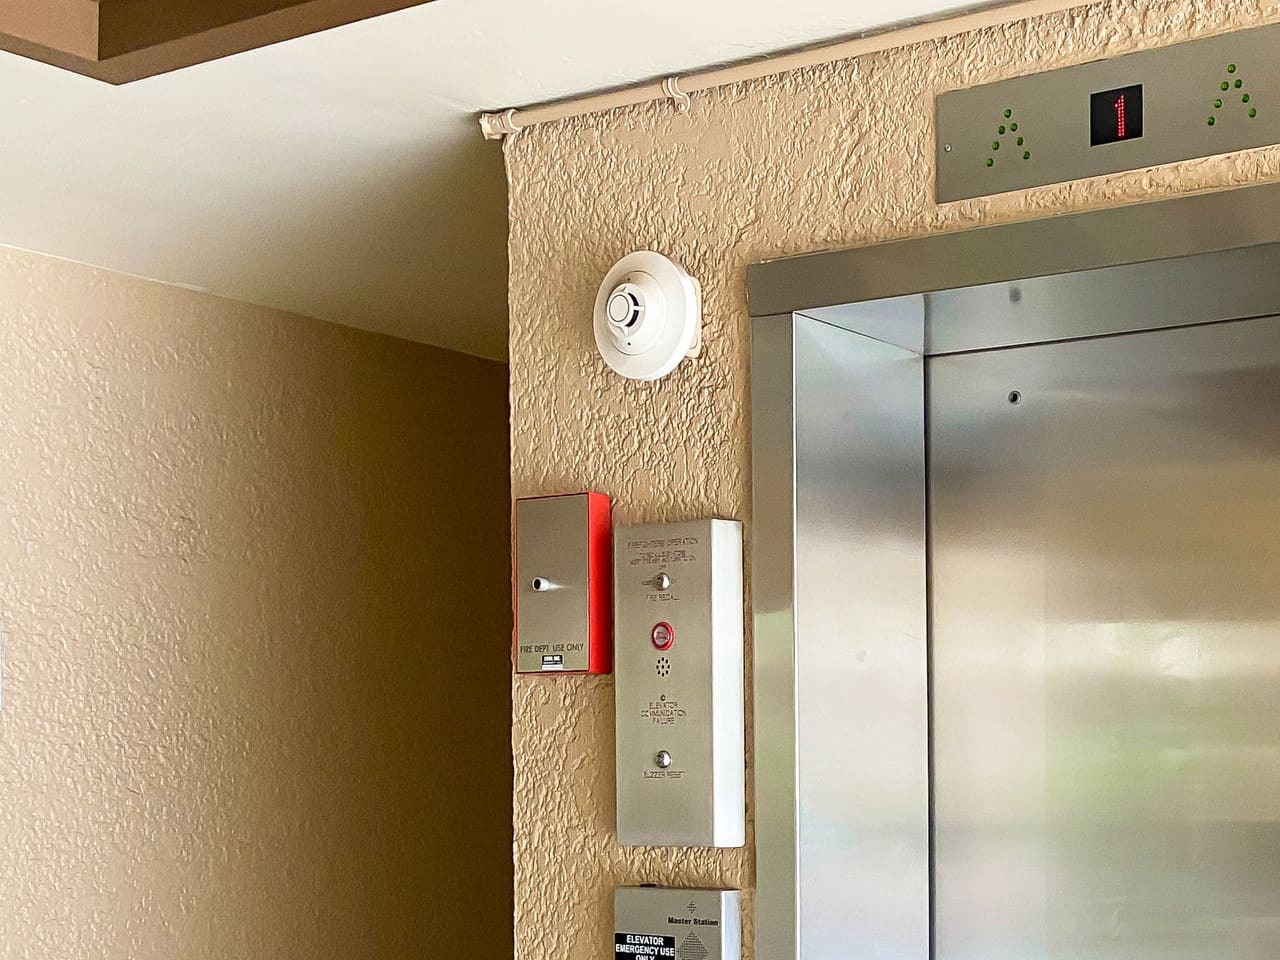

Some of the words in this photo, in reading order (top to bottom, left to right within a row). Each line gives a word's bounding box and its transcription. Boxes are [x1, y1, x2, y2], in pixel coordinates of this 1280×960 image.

[1114, 94, 1125, 137] 1
[520, 645, 532, 653] FIRE
[567, 643, 584, 651] ONLY
[668, 917, 692, 925] Master
[693, 918, 719, 926] Station
[626, 935, 664, 945] ELEVATOR
[616, 944, 659, 955] EMERGENCY
[660, 947, 675, 956] USE
